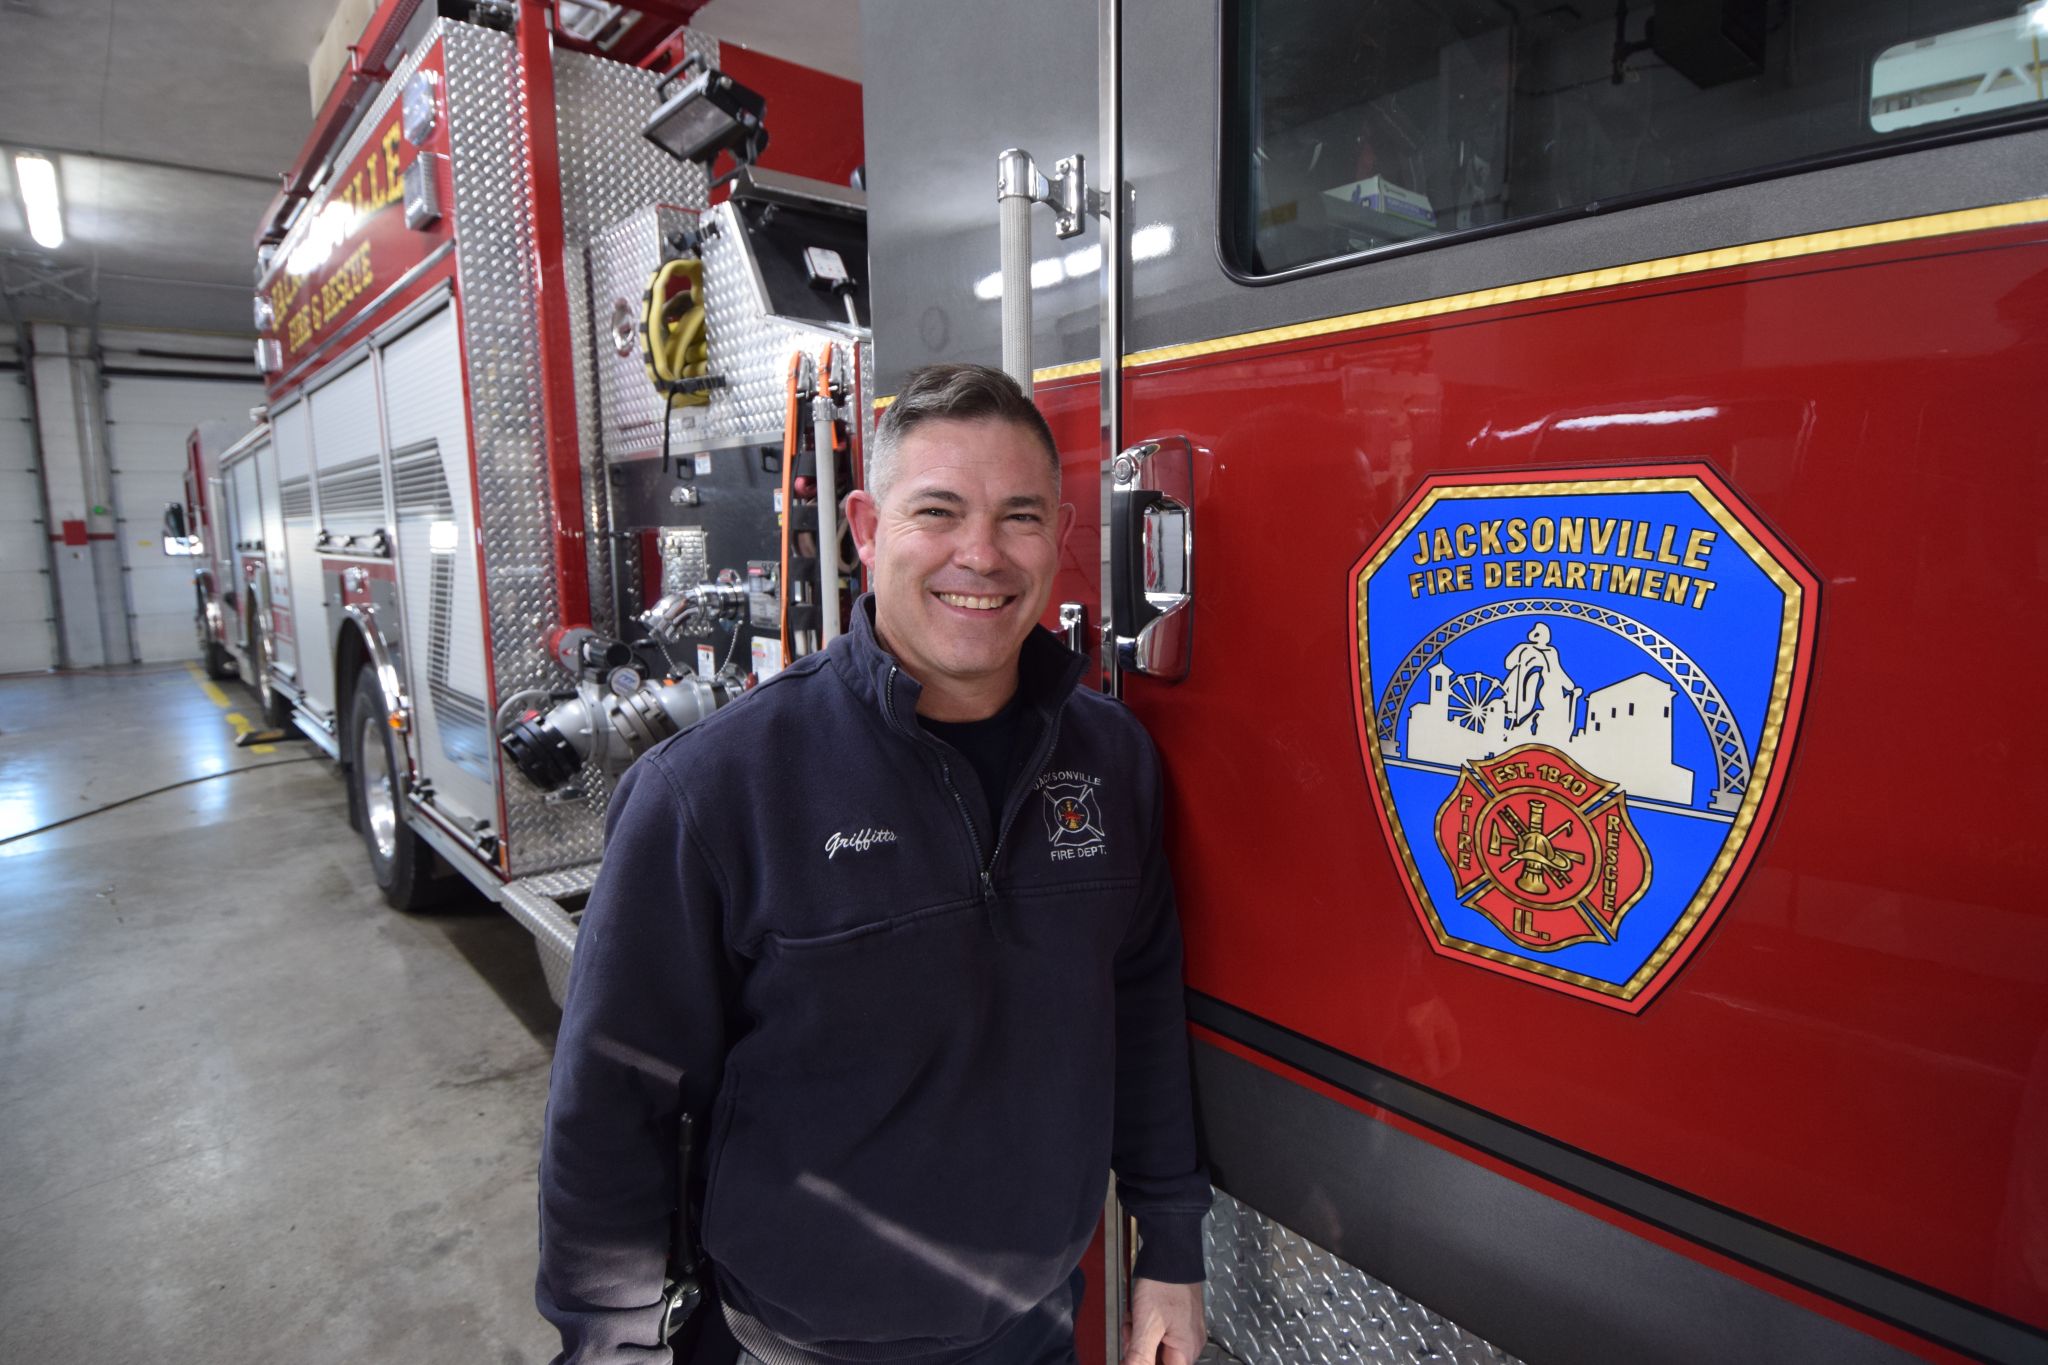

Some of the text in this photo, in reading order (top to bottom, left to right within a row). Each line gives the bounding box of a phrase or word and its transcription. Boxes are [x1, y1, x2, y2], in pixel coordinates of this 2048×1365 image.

[321, 240, 374, 323] RESCUE
[1412, 516, 1718, 571] JACKSONVILLE
[1408, 560, 1717, 610] FIRE DEPARTMENT
[1033, 771, 1101, 790] JACKSONVILLE
[1491, 762, 1588, 798] EST. 1840
[1050, 845, 1107, 862] FIRE DEPT.
[1458, 795, 1474, 870] FIRE
[1602, 814, 1621, 912] RESCUE
[1513, 907, 1551, 942] IL.
